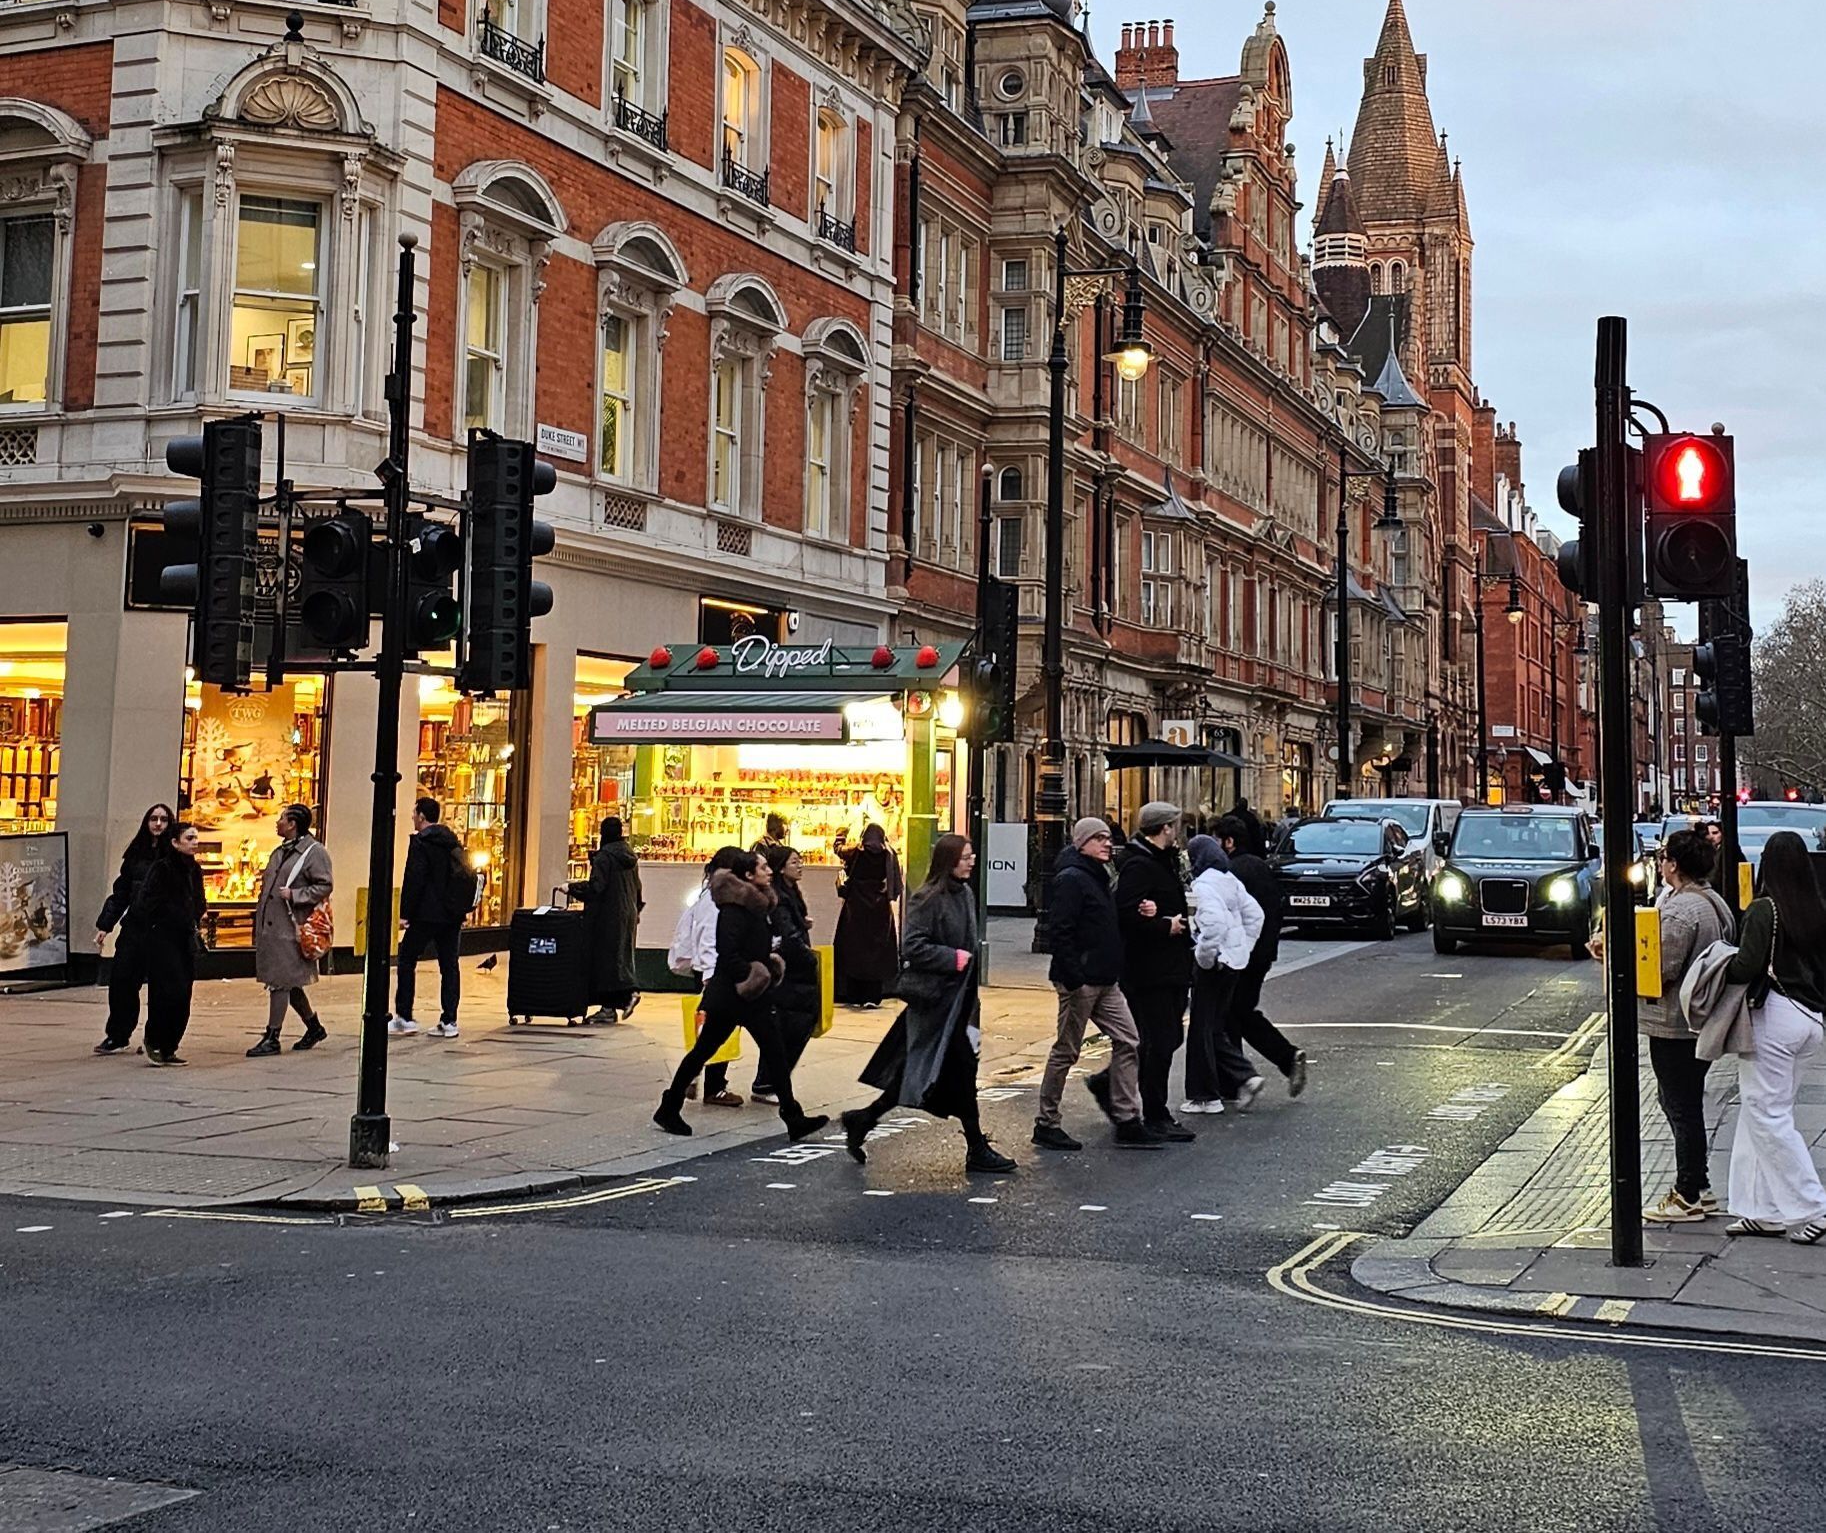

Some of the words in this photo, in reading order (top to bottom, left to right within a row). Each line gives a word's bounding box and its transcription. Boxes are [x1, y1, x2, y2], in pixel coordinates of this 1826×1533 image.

[556, 432, 576, 447] STREET
[731, 634, 833, 678] Dipped
[232, 707, 262, 718] TWG
[616, 718, 668, 732] MELTED
[671, 719, 735, 733] BELGIAN
[737, 719, 822, 733] CHOCOLATE
[1167, 726, 1188, 746] a
[1214, 729, 1225, 738] 65
[1485, 916, 1507, 925] LS73
[1301, 1180, 1393, 1208] LOOK
